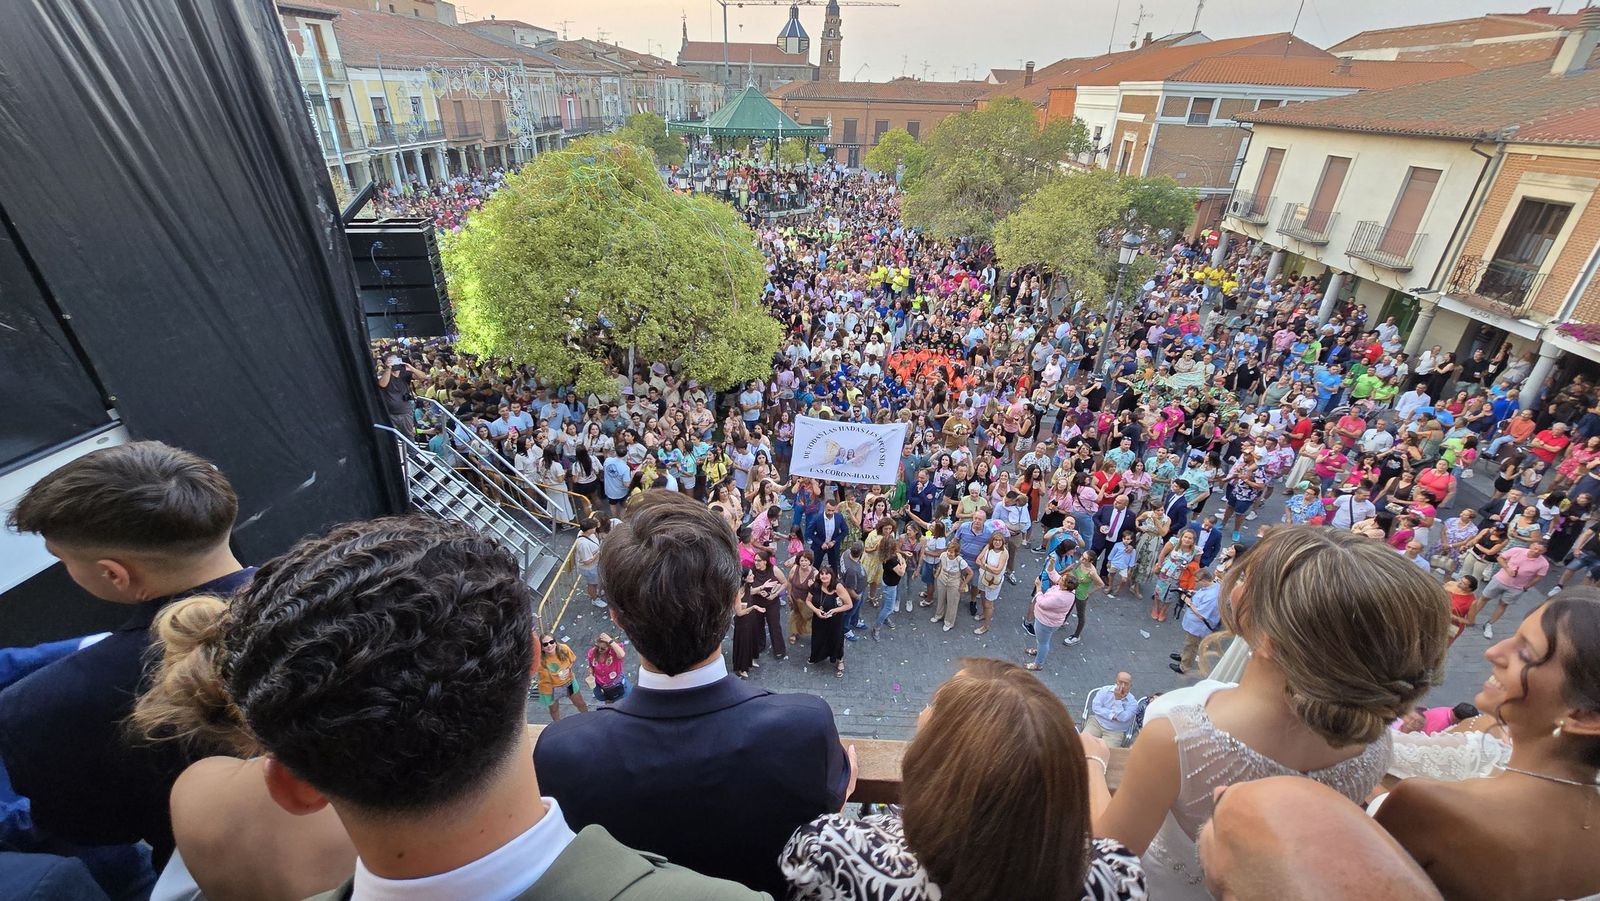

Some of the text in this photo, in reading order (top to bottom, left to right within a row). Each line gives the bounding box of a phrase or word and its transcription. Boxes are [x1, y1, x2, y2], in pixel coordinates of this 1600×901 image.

[803, 450, 811, 459] DE
[808, 433, 825, 450] TODAS
[822, 427, 838, 436] LAS
[838, 425, 864, 433] HADAS
[809, 467, 824, 475] LAS
